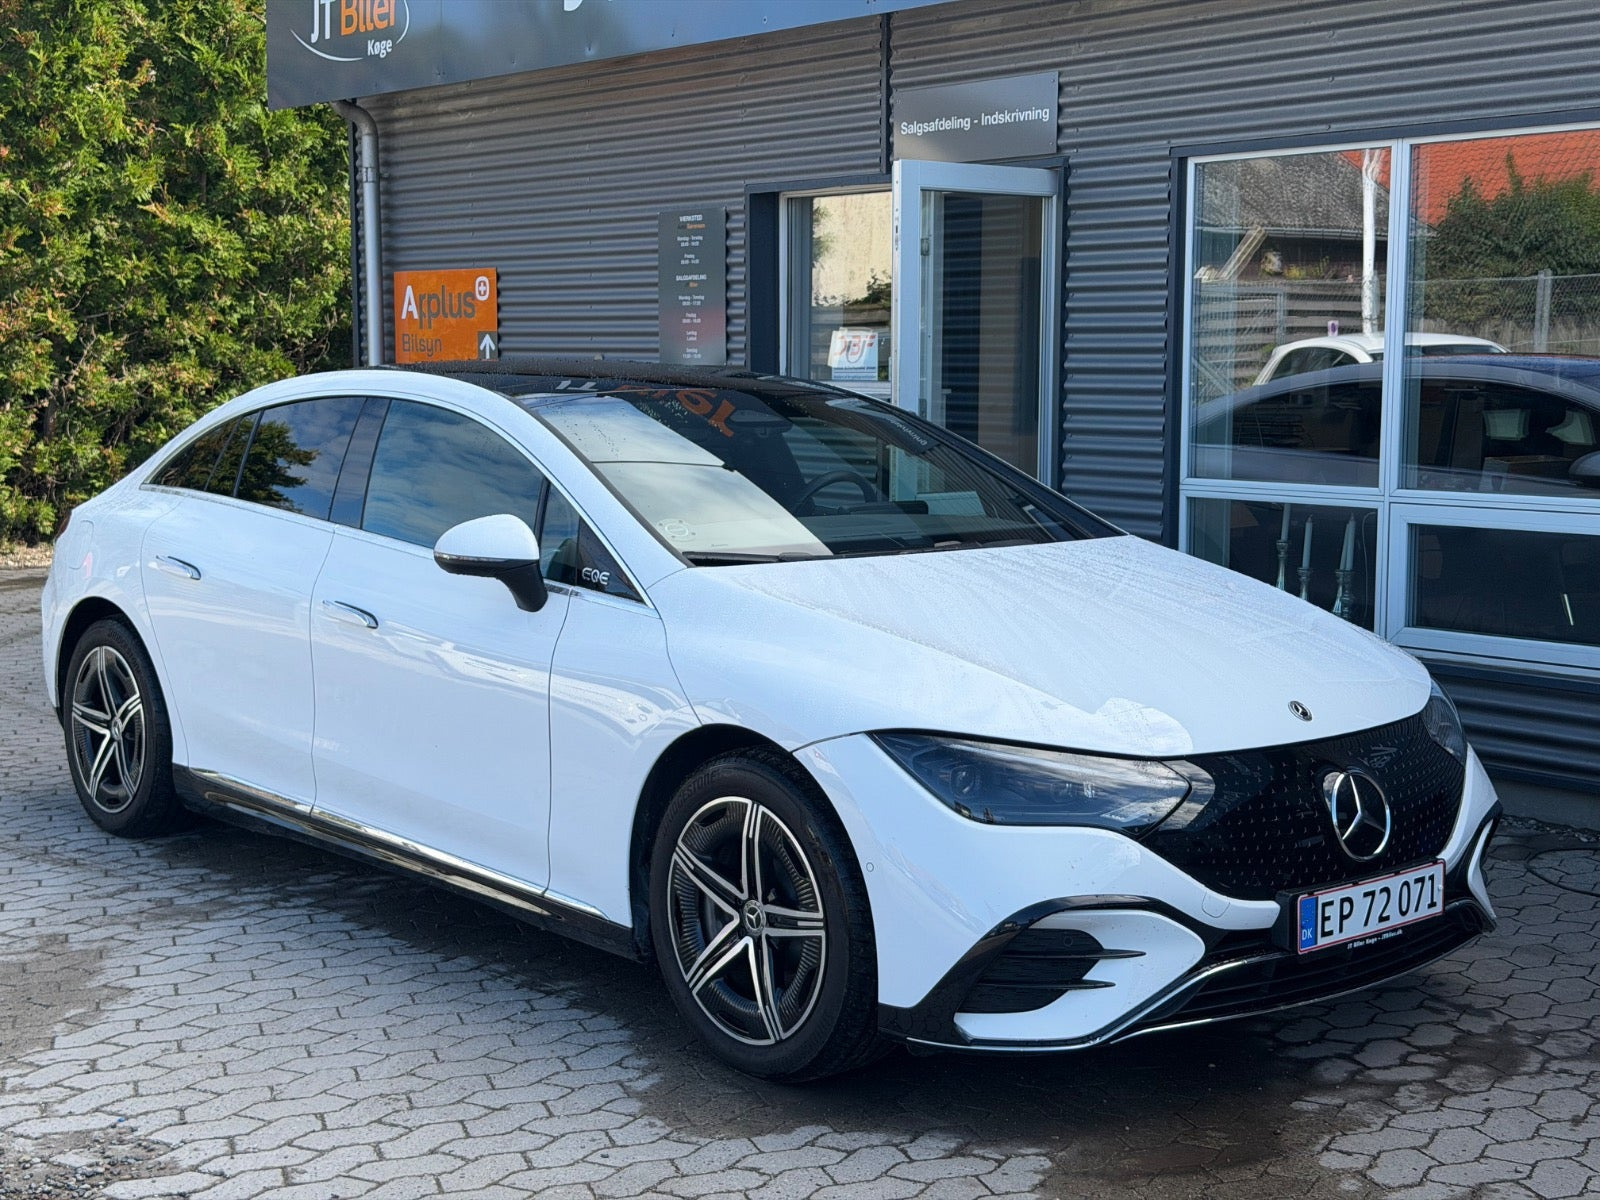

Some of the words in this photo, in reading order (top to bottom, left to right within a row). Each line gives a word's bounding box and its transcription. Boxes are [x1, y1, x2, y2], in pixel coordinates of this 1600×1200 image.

[310, 0, 336, 44] JT
[367, 39, 393, 58] Køge
[900, 117, 971, 136] Salgsafdeling
[981, 107, 1051, 126] Indskrivning
[401, 333, 443, 357] Bilsyn
[581, 567, 610, 585] EQE
[1320, 896, 1355, 938] EP
[1362, 886, 1391, 928] 72
[1397, 872, 1438, 917] 071
[1301, 928, 1314, 941] DK
